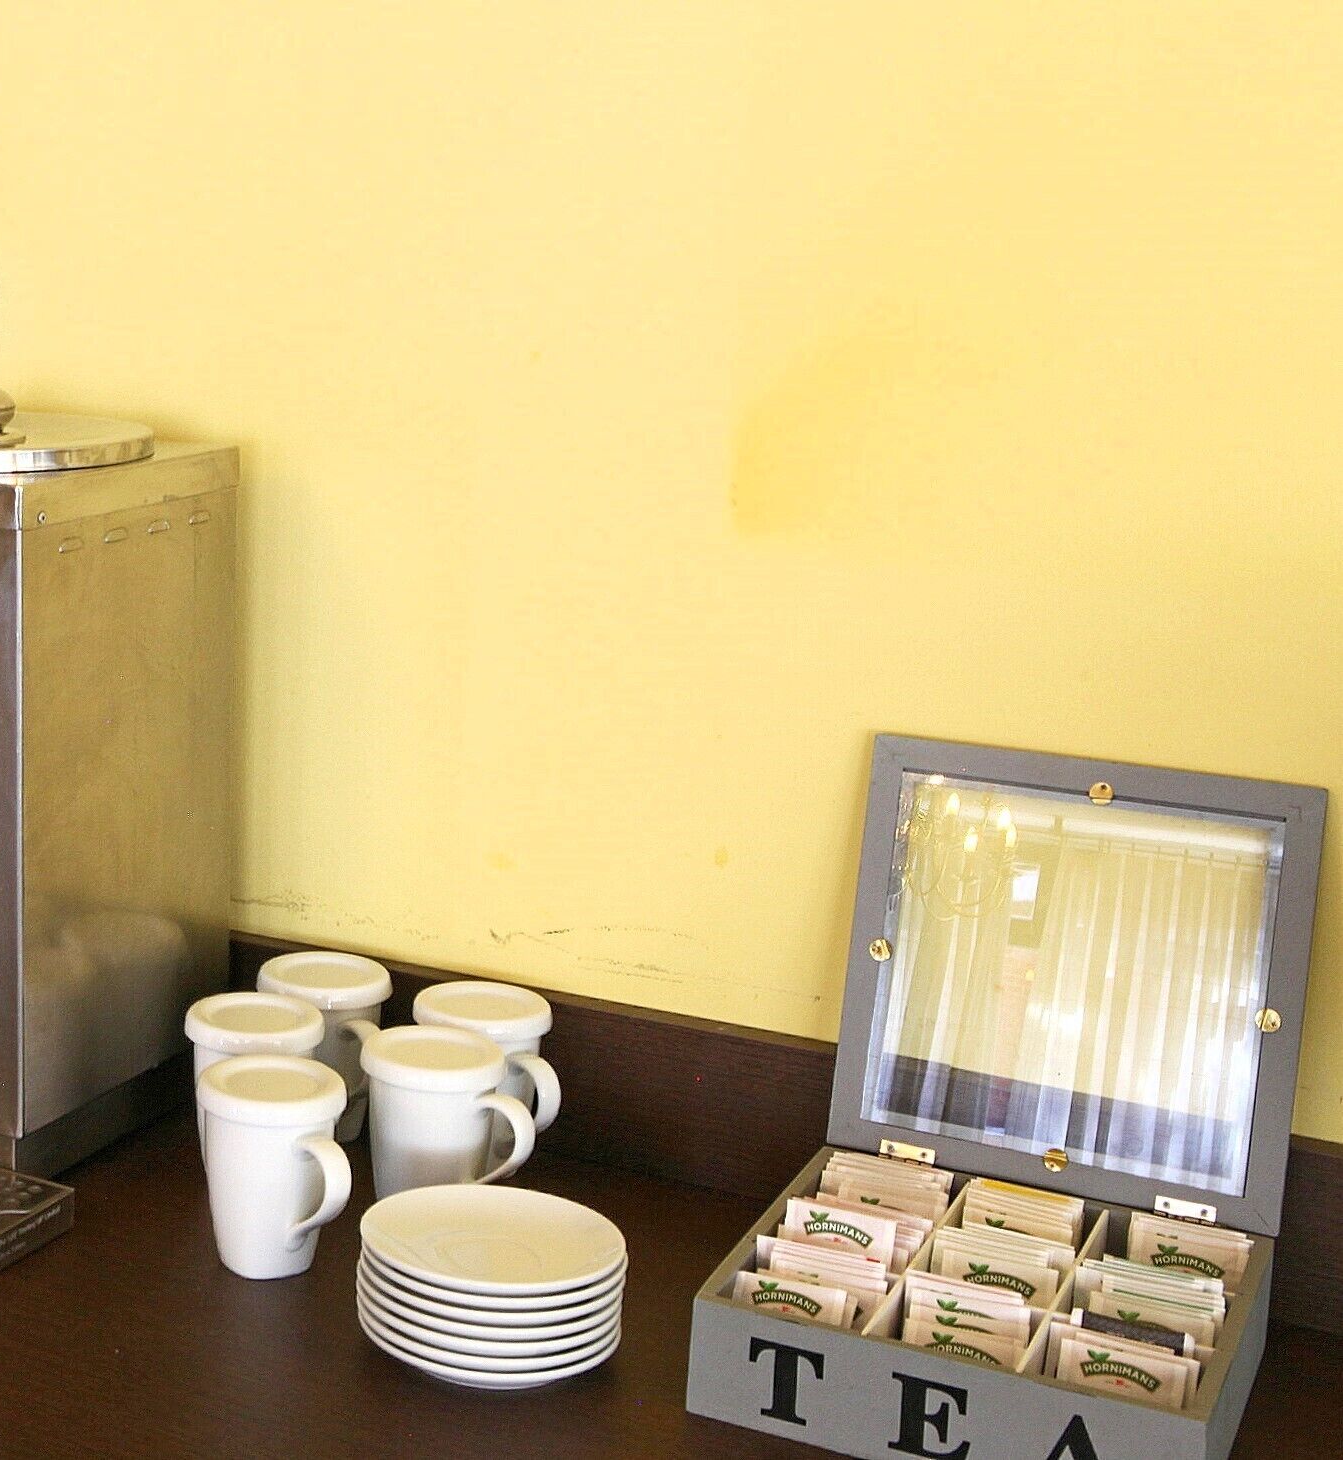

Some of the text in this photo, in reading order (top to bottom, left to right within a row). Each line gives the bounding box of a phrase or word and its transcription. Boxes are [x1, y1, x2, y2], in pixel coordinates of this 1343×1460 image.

[806, 1221, 872, 1246] HORNIMANS
[1154, 1255, 1220, 1277] HORNIMANS
[967, 1274, 1032, 1295] HORNIMANS
[754, 1290, 818, 1314] HORNIMANS
[1084, 1361, 1156, 1389] HORNIMANS
